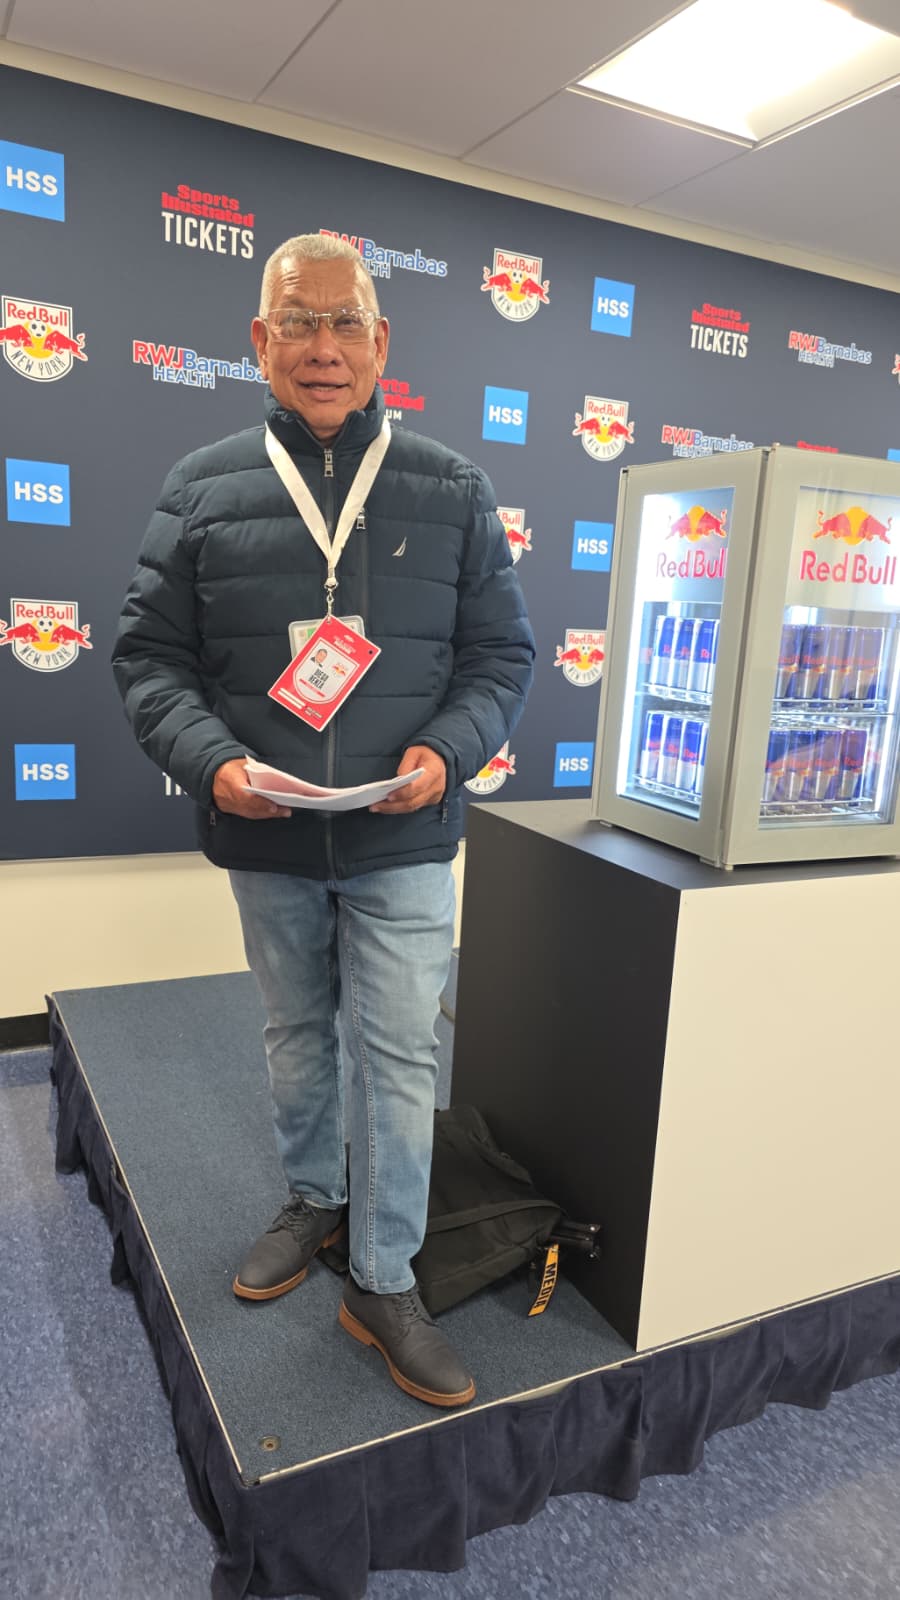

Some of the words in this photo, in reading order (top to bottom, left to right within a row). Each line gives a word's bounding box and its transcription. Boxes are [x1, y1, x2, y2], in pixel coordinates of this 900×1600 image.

[6, 166, 58, 197] HSS
[161, 191, 254, 228] Illustrated
[177, 184, 239, 211] Sports
[161, 211, 254, 259] TICKETS
[7, 302, 37, 321] Red
[38, 307, 68, 327] Bull
[596, 296, 629, 318] HSS
[690, 324, 749, 358] TICKETS
[788, 330, 872, 365] RWJBarnabas
[10, 349, 34, 374] NEW
[38, 355, 66, 377] YORK
[152, 364, 216, 390] HEALTH
[488, 404, 523, 426] HSS
[14, 480, 64, 505] HSS
[577, 538, 609, 556] HSS
[656, 550, 690, 578] Red
[800, 550, 848, 583] Red
[851, 554, 896, 585] Bull
[15, 604, 44, 618] Red
[46, 605, 74, 620] Bull
[22, 763, 70, 782] HSS
[559, 757, 589, 773] HSS
[534, 1263, 556, 1309] MEDIA
